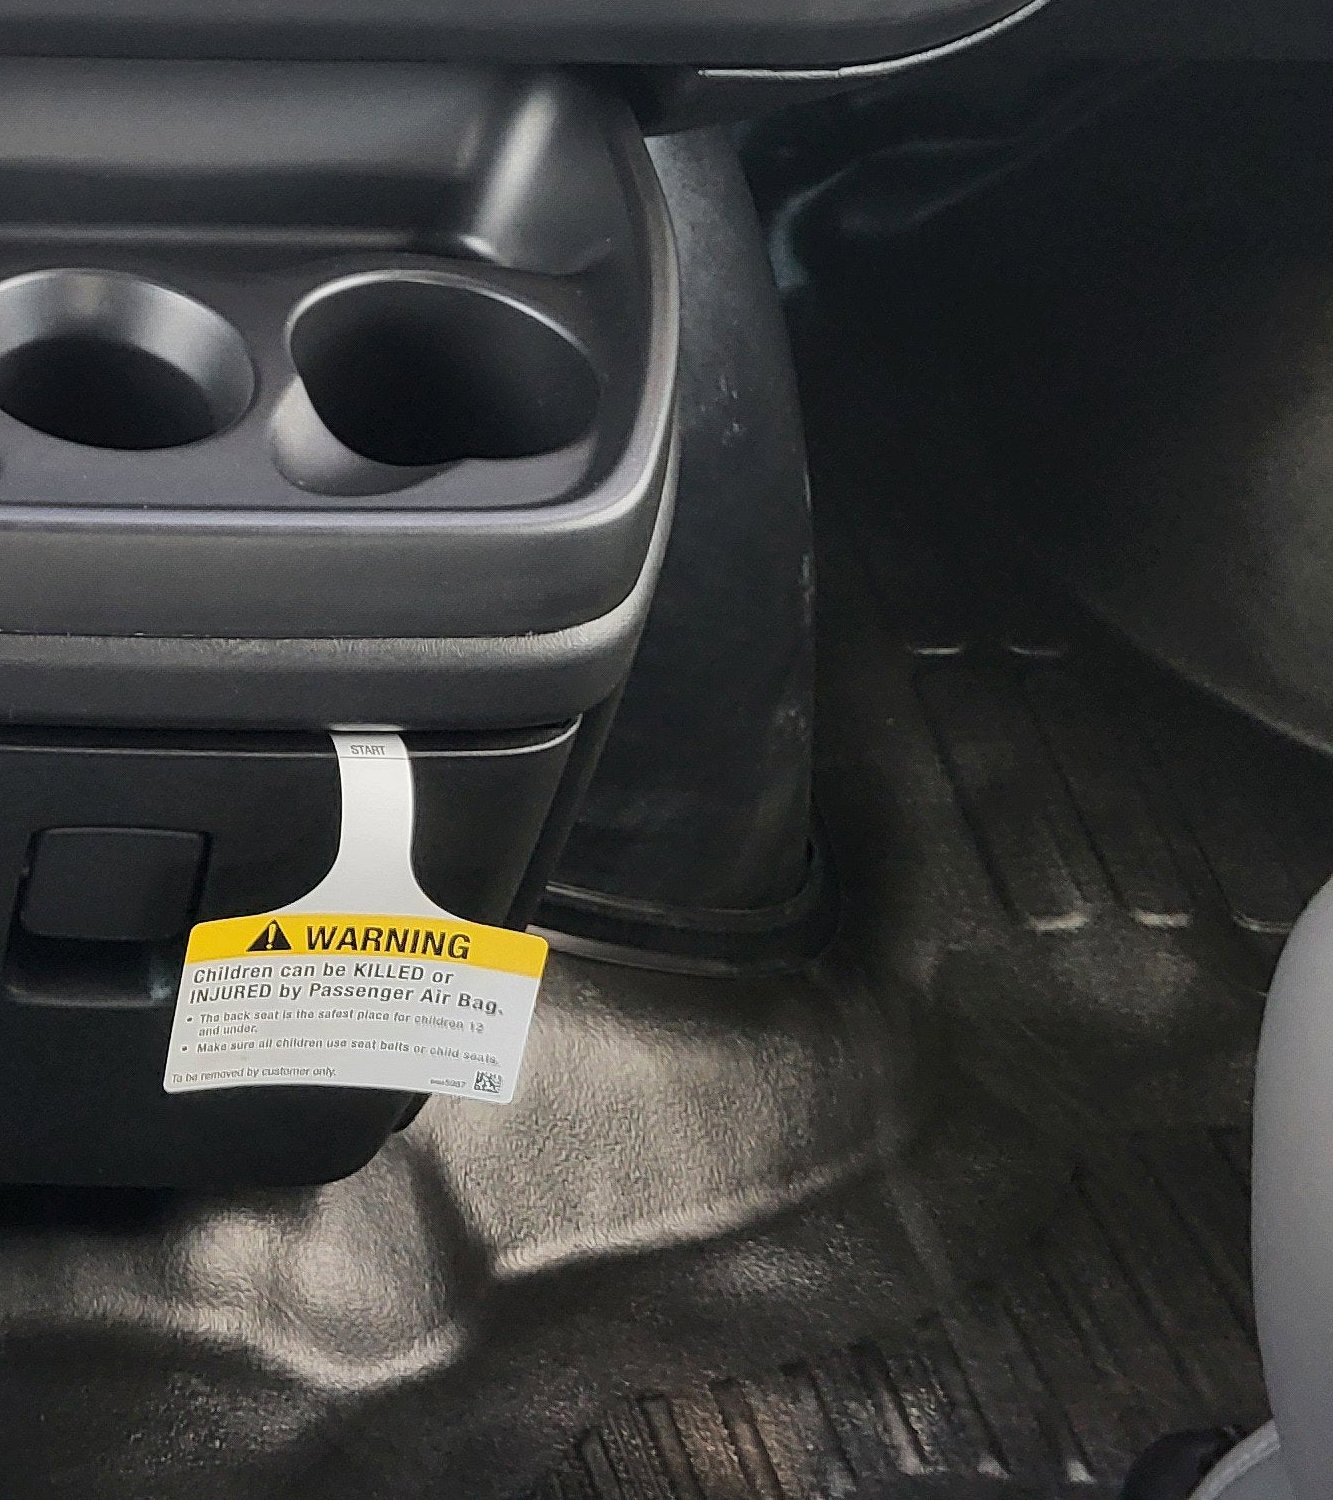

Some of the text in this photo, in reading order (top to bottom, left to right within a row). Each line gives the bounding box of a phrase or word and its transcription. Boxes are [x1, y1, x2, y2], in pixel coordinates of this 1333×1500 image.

[350, 744, 386, 756] START
[306, 925, 471, 960] WARNING
[193, 962, 454, 984] Children can be KILLED or
[190, 982, 504, 1016] INJURED by Passenger Air Bag.
[198, 1023, 258, 1037] and under.
[200, 1013, 220, 1024] The
[223, 1010, 251, 1021] back
[254, 1009, 280, 1020] seat
[282, 1009, 292, 1019] is
[296, 1009, 315, 1019] the
[317, 1008, 354, 1019] safest
[356, 1009, 390, 1021] place
[393, 1011, 411, 1023] for
[414, 1014, 464, 1032] children
[196, 1041, 227, 1053] Make
[230, 1041, 255, 1051] sure
[258, 1039, 273, 1049] all
[276, 1038, 323, 1049] children
[326, 1040, 347, 1049] use
[351, 1039, 376, 1050] seat
[380, 1039, 410, 1052] belts
[413, 1044, 426, 1054] or
[429, 1047, 460, 1059] child
[200, 1067, 245, 1081] removed
[247, 1067, 260, 1078] by
[261, 1067, 310, 1077] customer
